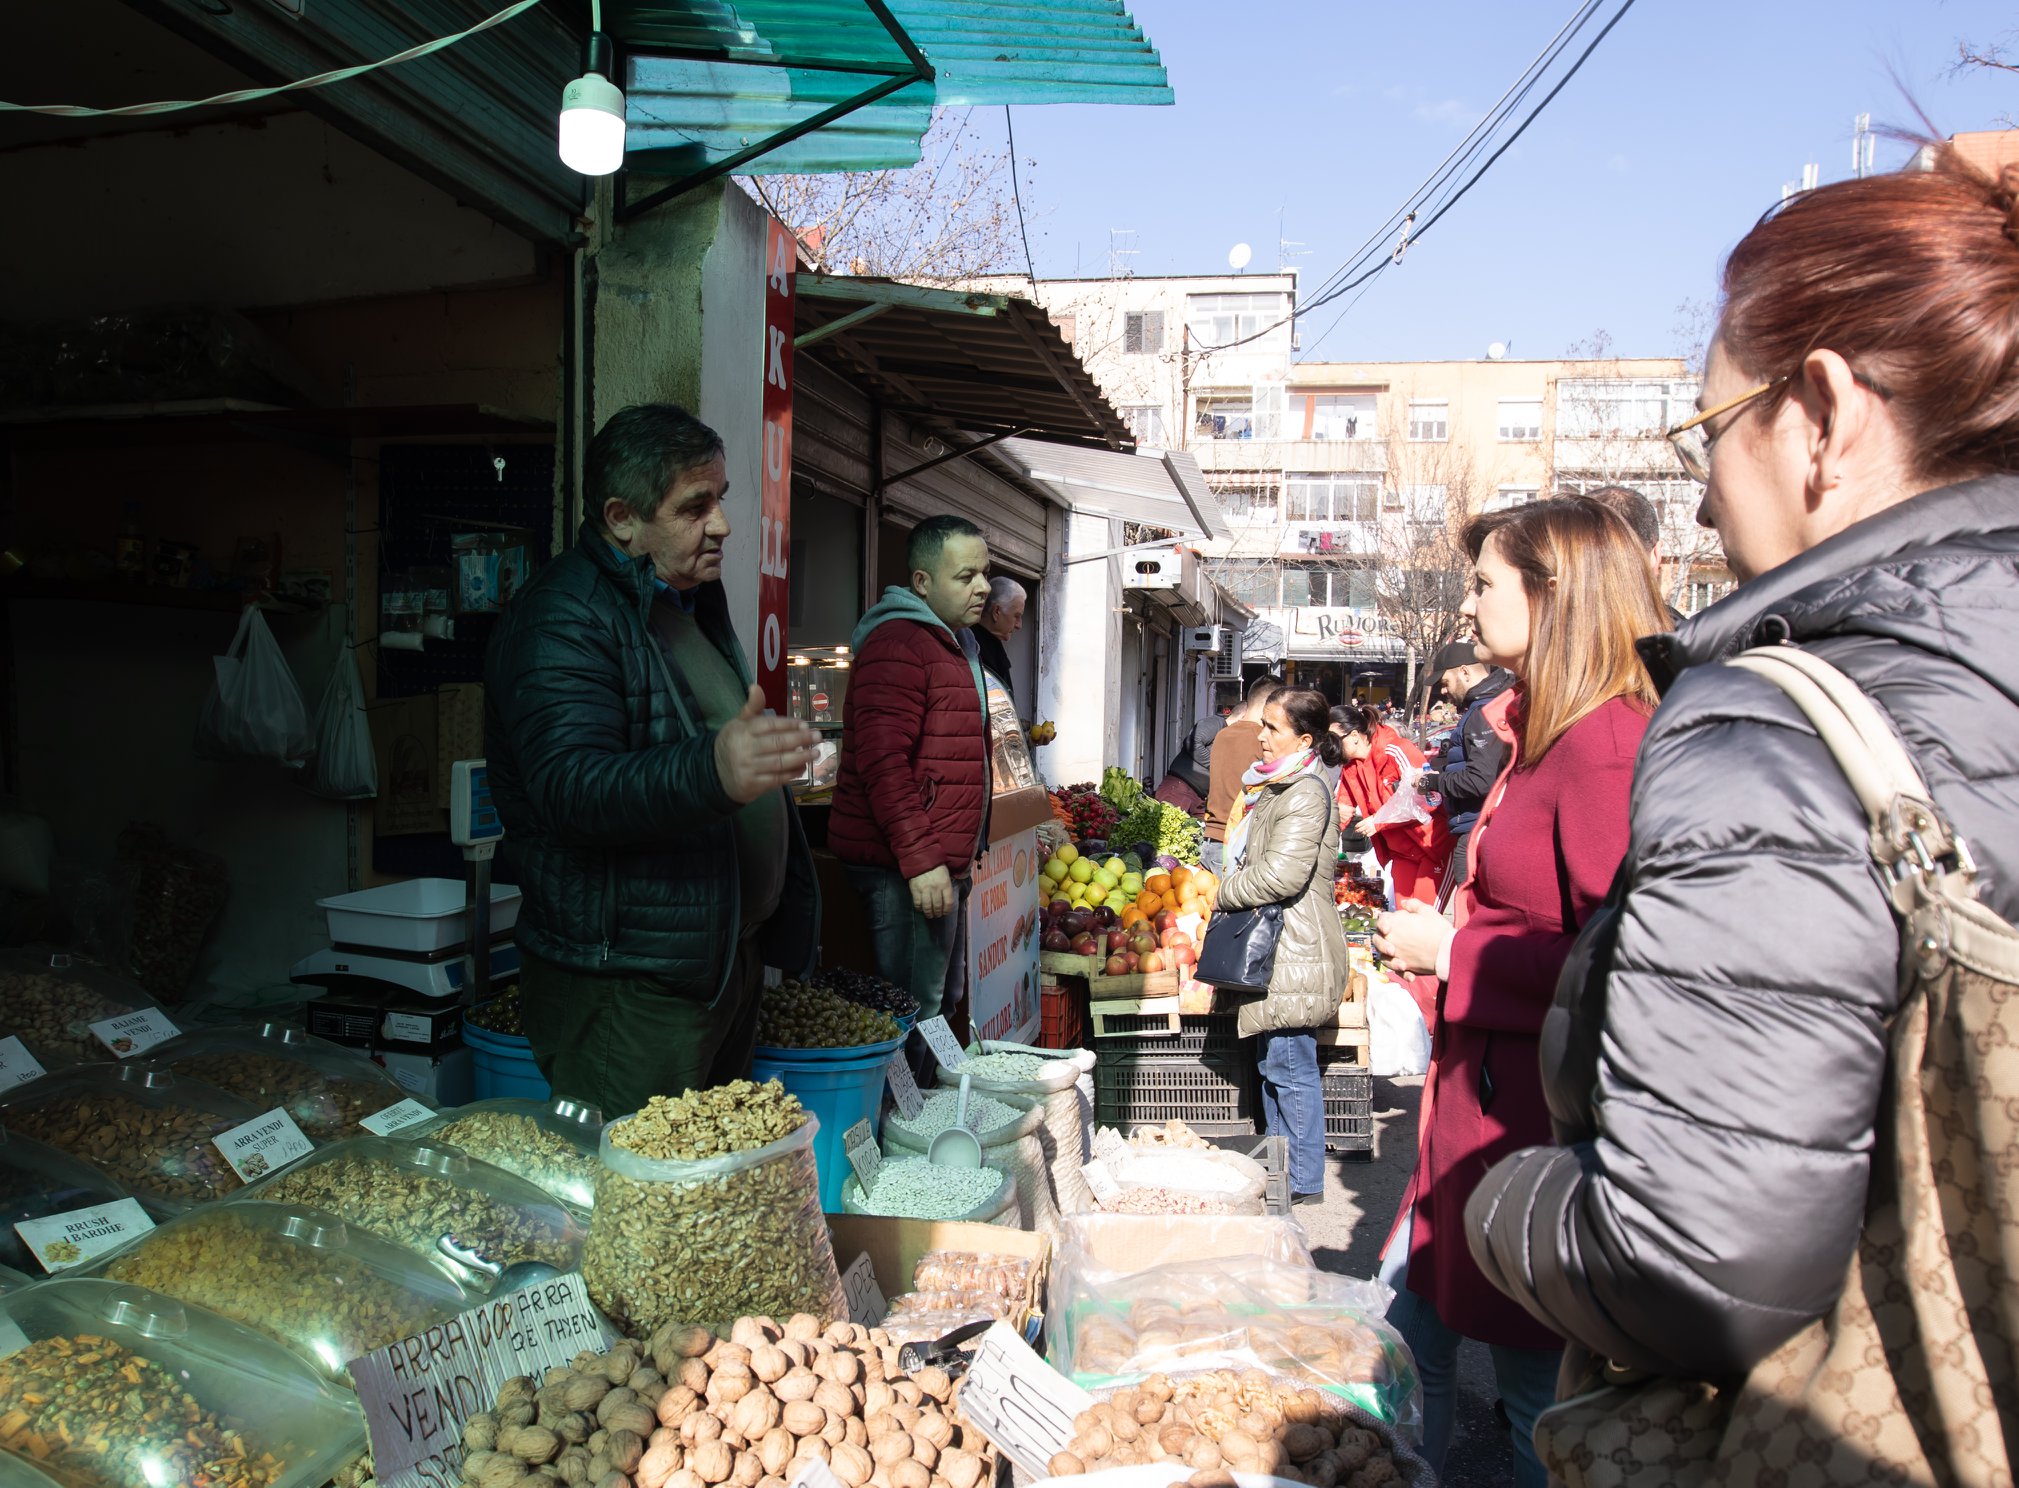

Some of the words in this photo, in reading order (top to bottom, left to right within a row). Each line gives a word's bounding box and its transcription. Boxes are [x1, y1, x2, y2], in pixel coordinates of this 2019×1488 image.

[760, 233, 789, 717] AKULLO
[123, 1025, 152, 1037] VENDI
[232, 1132, 258, 1150] ARRA
[255, 1119, 285, 1138] VENDI
[252, 1135, 280, 1153] SUPER
[63, 1235, 71, 1244] I
[71, 1223, 125, 1242] BARDHE
[65, 1216, 109, 1233] RRUSH
[517, 1282, 573, 1319] ARRA
[388, 1318, 469, 1382] ARRA
